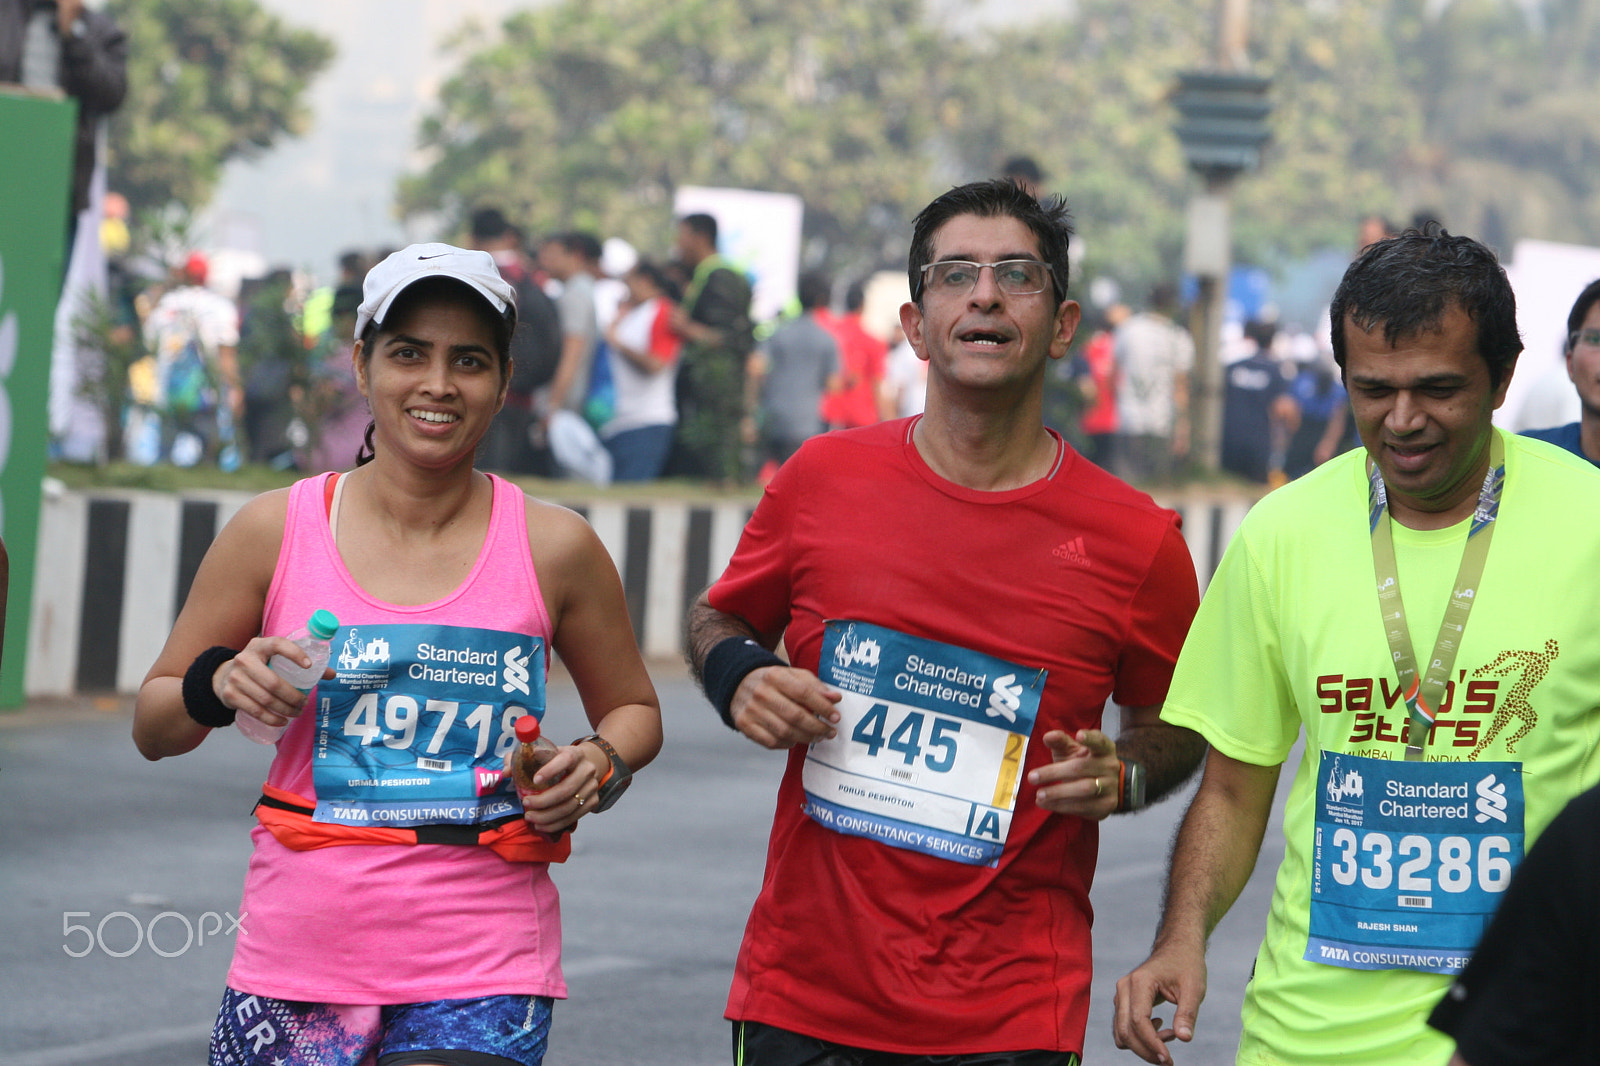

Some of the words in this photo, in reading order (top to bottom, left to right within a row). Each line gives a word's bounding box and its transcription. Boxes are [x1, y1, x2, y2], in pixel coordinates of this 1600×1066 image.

[1052, 548, 1090, 567] adidas
[417, 644, 497, 666] Standard
[408, 664, 497, 687] Chartered
[905, 654, 986, 690] Standard
[894, 673, 982, 709] Chartered
[344, 693, 528, 758] 49718
[851, 702, 962, 773] 445
[1004, 734, 1022, 762] 2
[1427, 754, 1460, 762] INDIA
[381, 778, 430, 787] PESHOTON
[480, 774, 500, 788] W
[1386, 780, 1468, 798] Standard
[838, 784, 865, 797] PORUS
[868, 792, 915, 808] PESHOTON
[332, 808, 368, 821] TATA
[372, 807, 465, 821] CONSULTANCY
[468, 802, 513, 819] SEVICES
[1379, 800, 1468, 819] Chartered
[810, 802, 834, 824] TATA
[836, 814, 924, 846] CONSULTANCY
[926, 835, 983, 860] SERVICES
[975, 810, 1000, 840] A
[1316, 848, 1321, 860] km
[1332, 828, 1512, 893] 33286
[1357, 922, 1391, 931] RAJESH
[1393, 924, 1418, 933] SHAH
[1320, 946, 1350, 962] TATA
[1353, 951, 1444, 968] CONSULTANCY
[1446, 957, 1472, 968] SER
[234, 990, 276, 1055] ER
[523, 996, 536, 1031] Reebo
